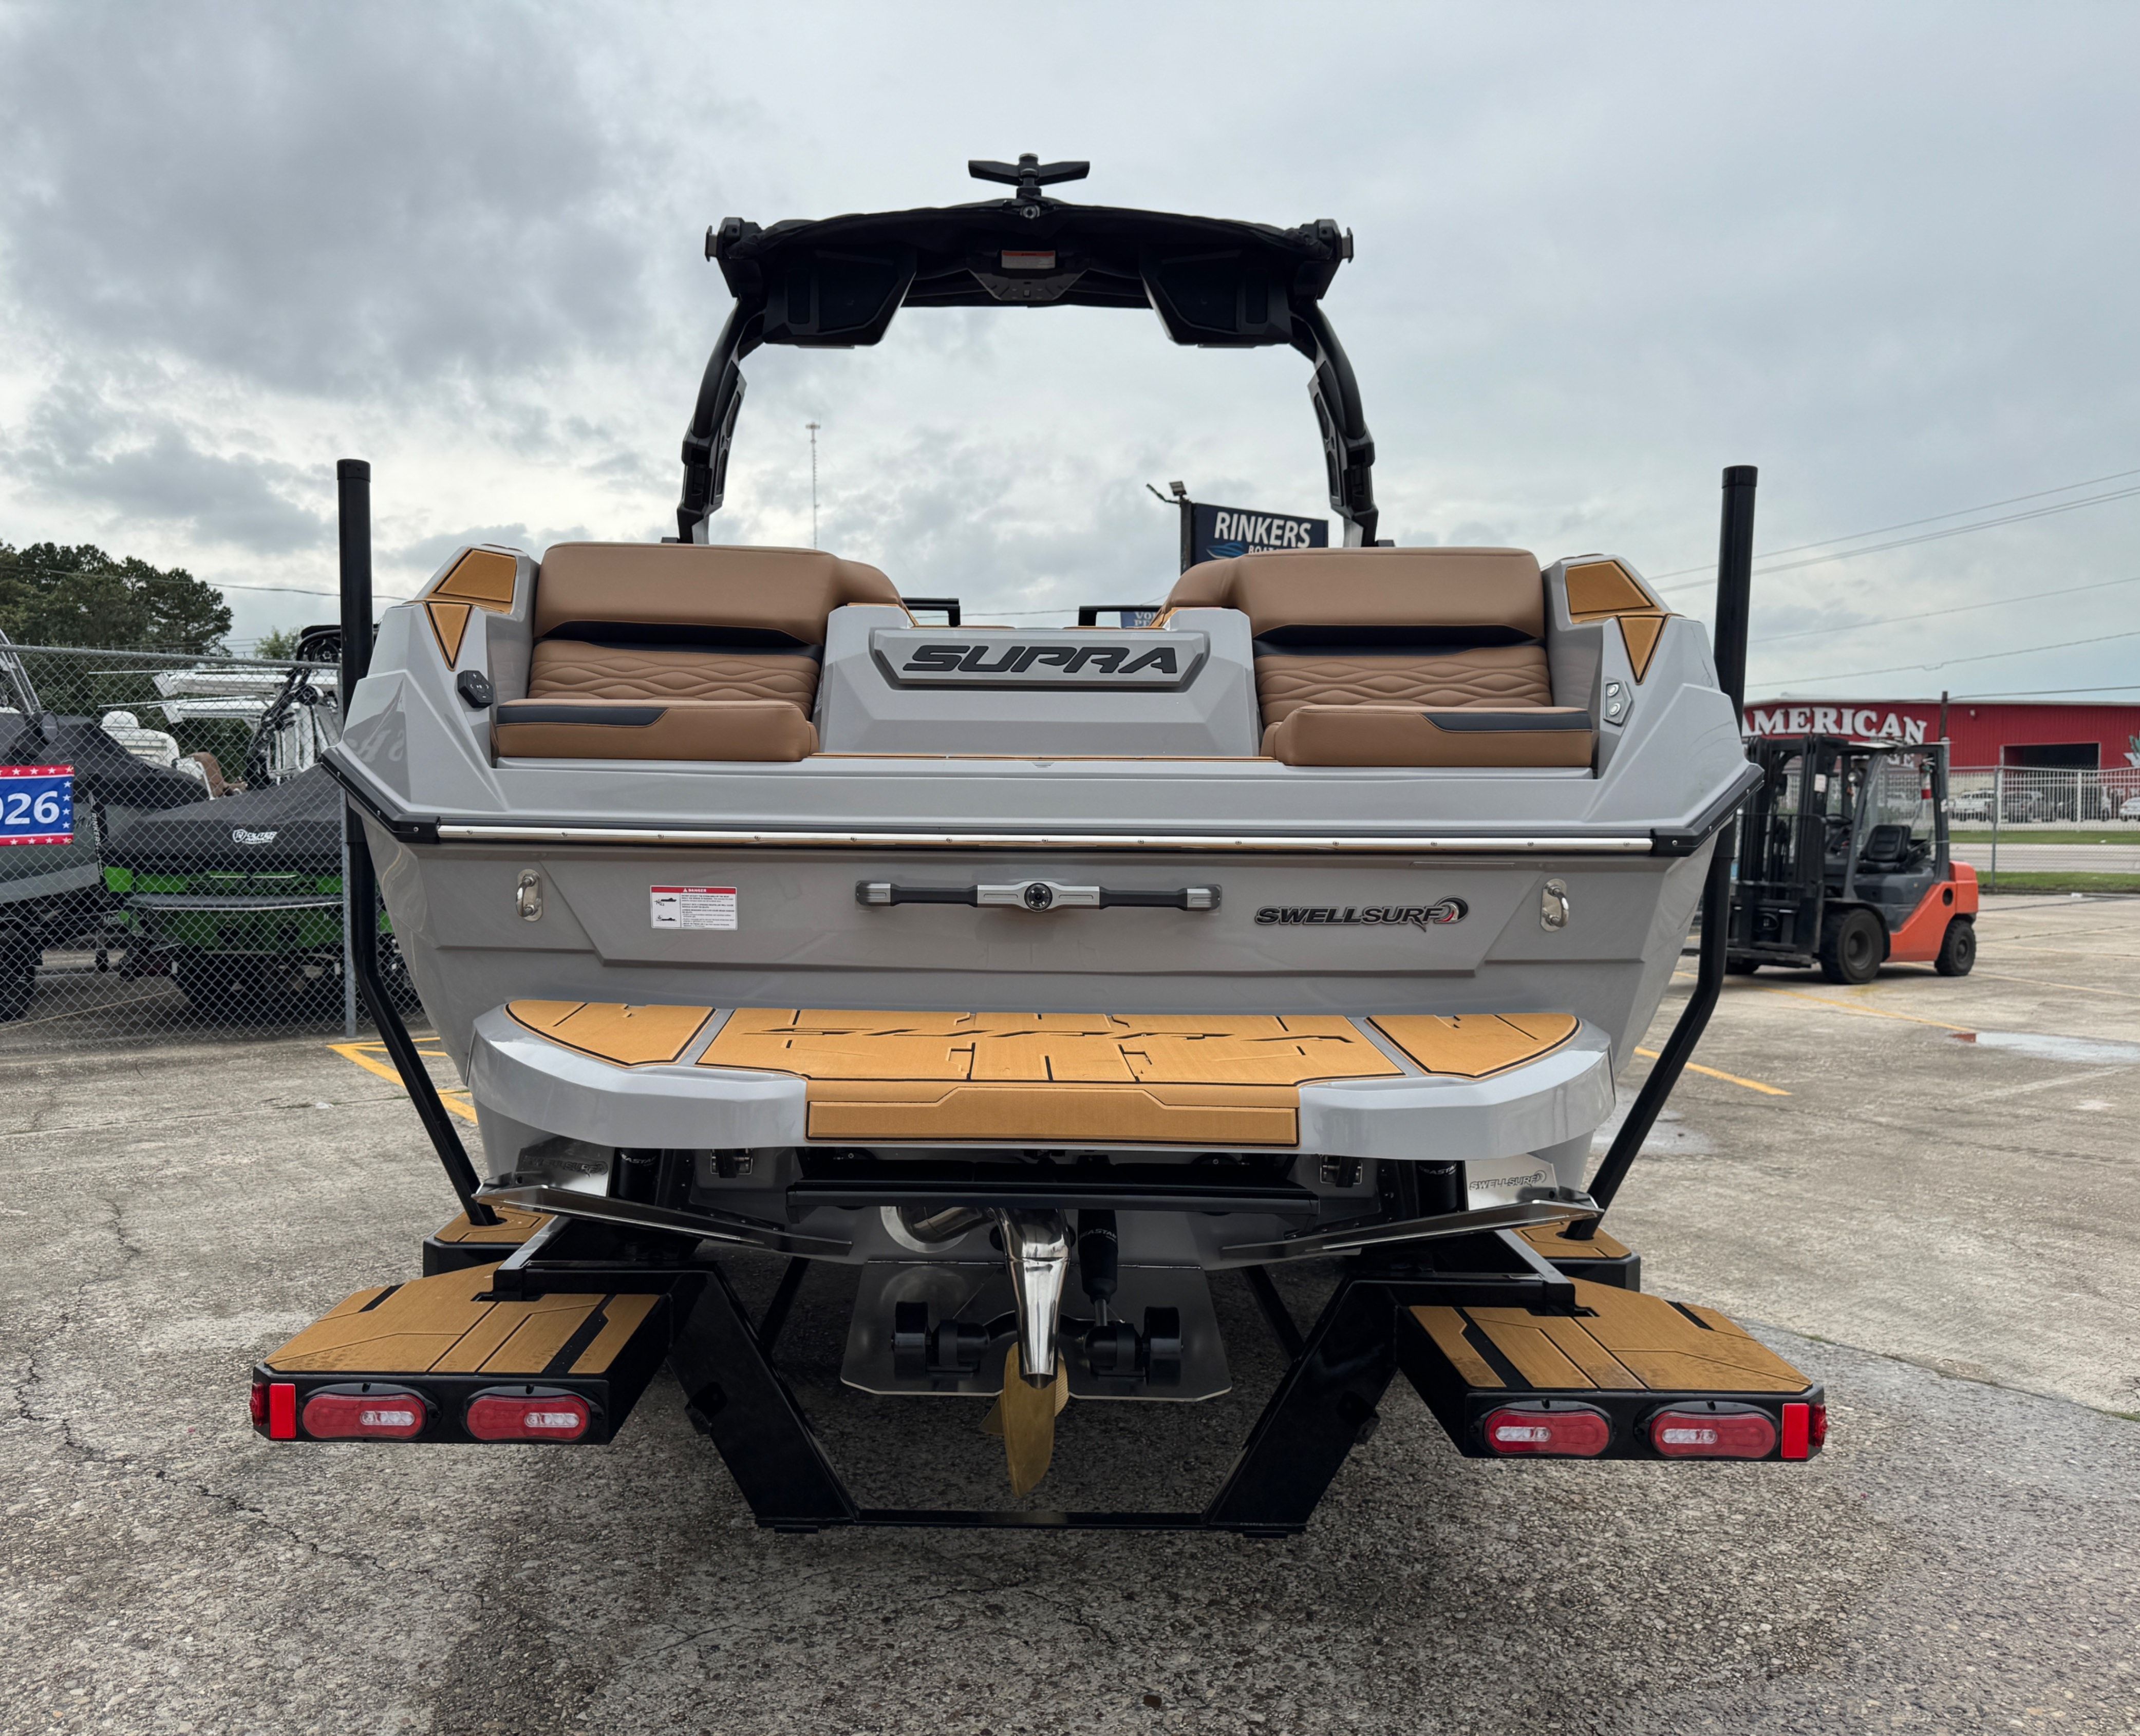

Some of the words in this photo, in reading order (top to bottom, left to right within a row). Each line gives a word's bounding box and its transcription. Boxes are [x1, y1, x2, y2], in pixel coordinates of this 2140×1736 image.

[1214, 512, 1311, 548] RINKERS
[903, 645, 1177, 674] SUPRA
[0, 791, 60, 825] 26
[1255, 906, 1442, 932] SWELLSURF
[1469, 1175, 1539, 1190] SWELLSURF
